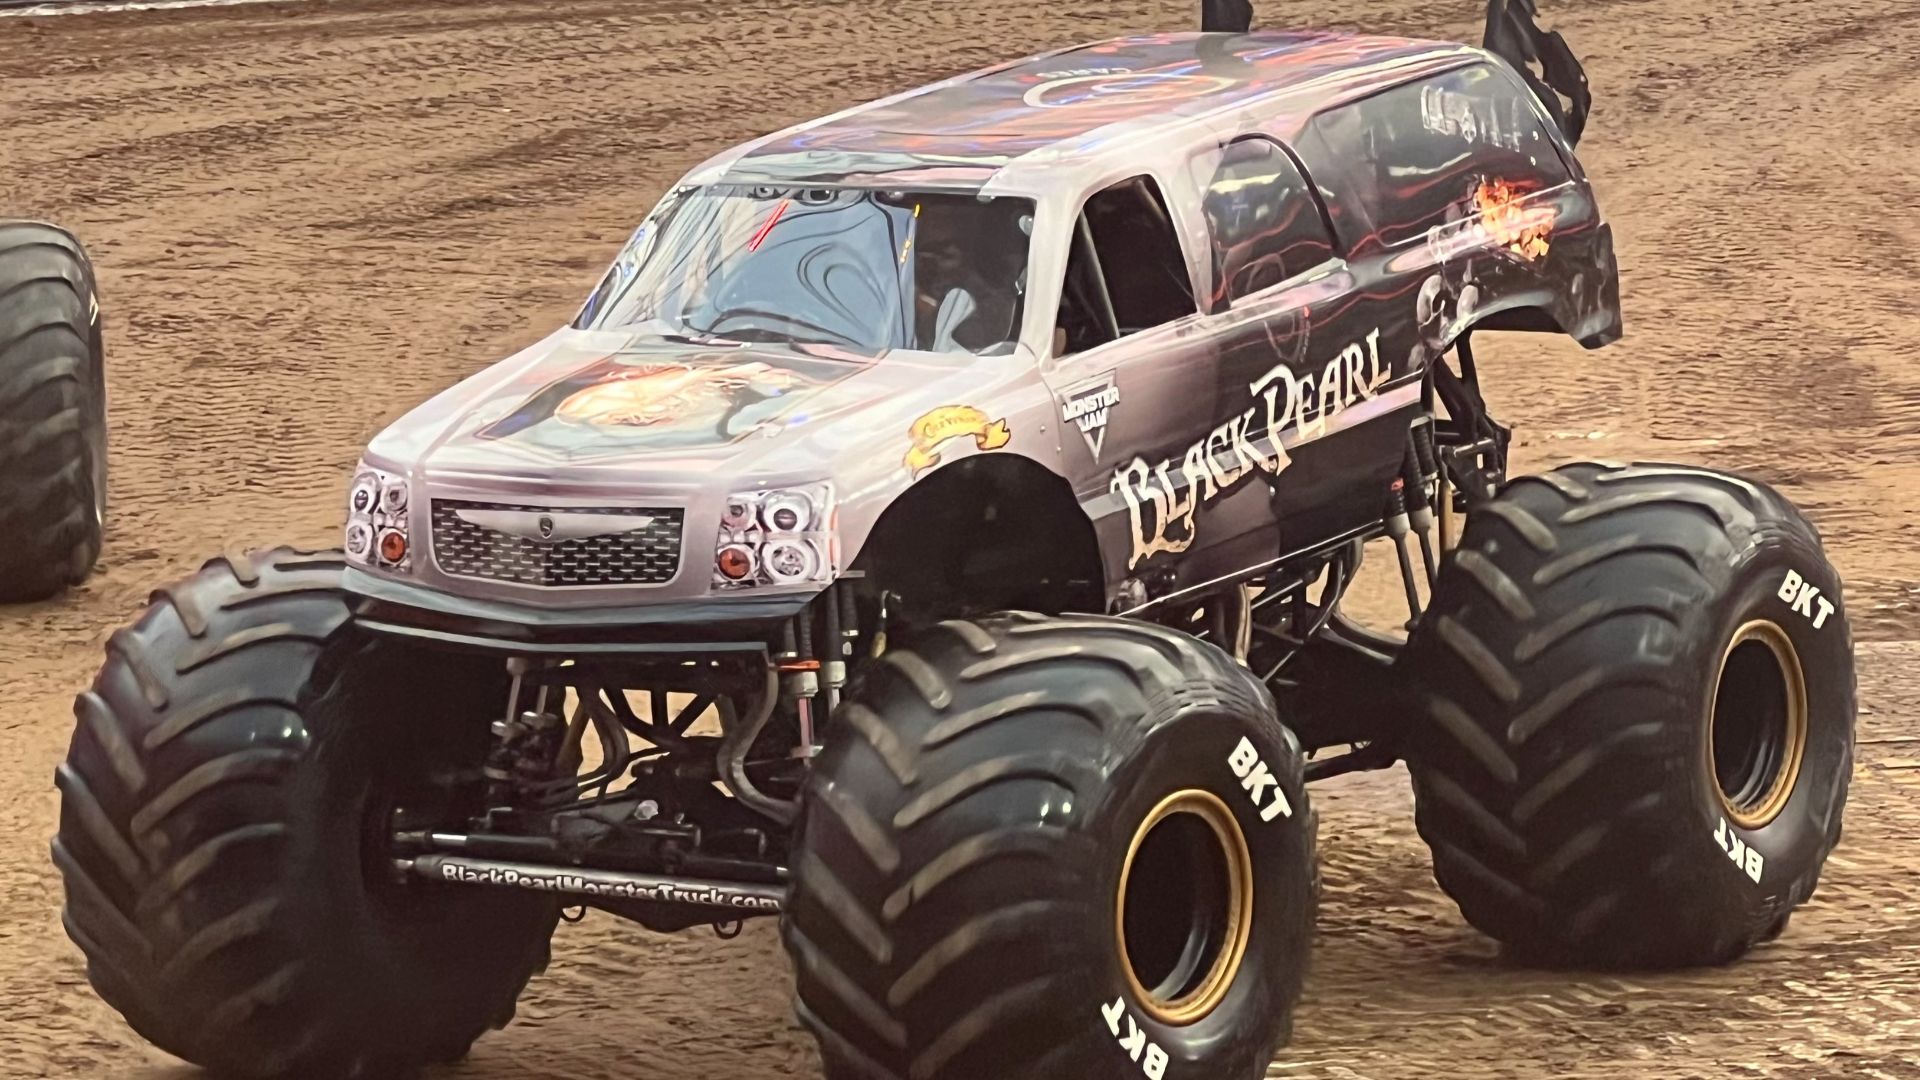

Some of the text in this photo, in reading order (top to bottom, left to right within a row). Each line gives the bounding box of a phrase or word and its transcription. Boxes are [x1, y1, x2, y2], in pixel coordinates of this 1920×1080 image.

[1062, 386, 1120, 423] MONSTER
[1078, 407, 1108, 433] JAM
[1110, 327, 1392, 570] BLACK PEARL
[1777, 568, 1835, 630] BKT
[1227, 735, 1293, 823] BKT
[1713, 816, 1765, 884] BKT
[442, 864, 782, 909] BlackPearlMonsterTruck.com
[1101, 995, 1169, 1080] BKT
